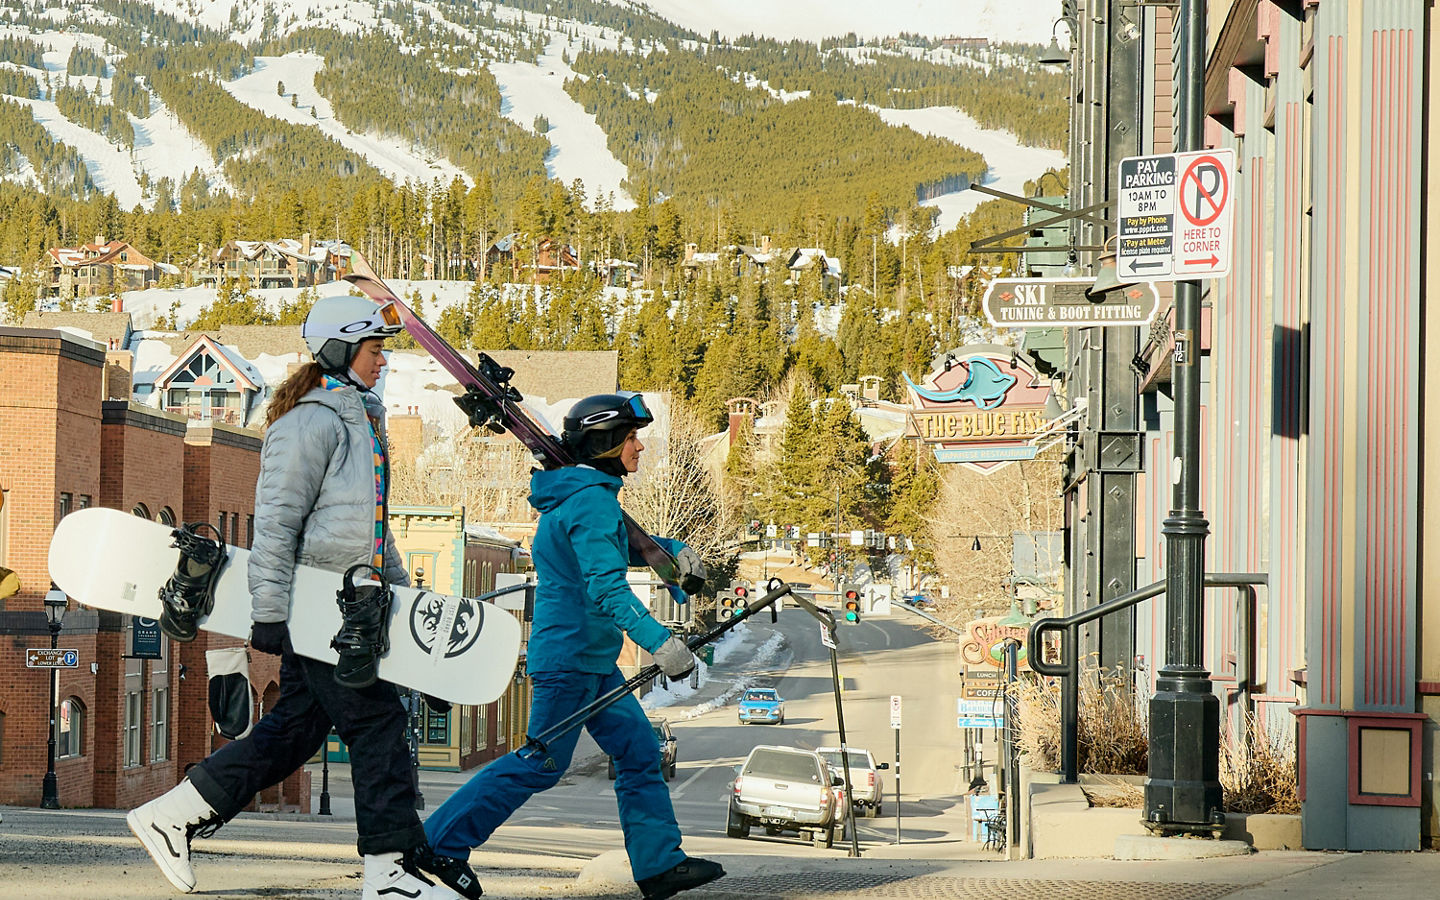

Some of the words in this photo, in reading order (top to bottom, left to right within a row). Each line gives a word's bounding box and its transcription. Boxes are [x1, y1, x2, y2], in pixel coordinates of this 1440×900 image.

[1137, 160, 1159, 174] PAY
[1125, 171, 1173, 188] PARKING
[1129, 190, 1152, 201] 10AM
[1155, 189, 1167, 200] TO
[1138, 201, 1157, 212] 8PM
[1127, 218, 1139, 227] Pay
[1139, 217, 1147, 226] by
[1147, 215, 1167, 224] Phone
[1184, 228, 1207, 240] HERE
[1209, 226, 1221, 238] TO
[1126, 239, 1139, 248] Pay
[1139, 239, 1146, 247] at
[1146, 237, 1167, 246] Meter
[1183, 240, 1221, 253] CORNER
[1014, 285, 1047, 305] SKI
[1000, 306, 1045, 321] TUNING
[1047, 306, 1057, 320] &
[1059, 306, 1091, 320] BOOT
[1093, 305, 1142, 319] FITTING
[67, 654, 75, 663] P
